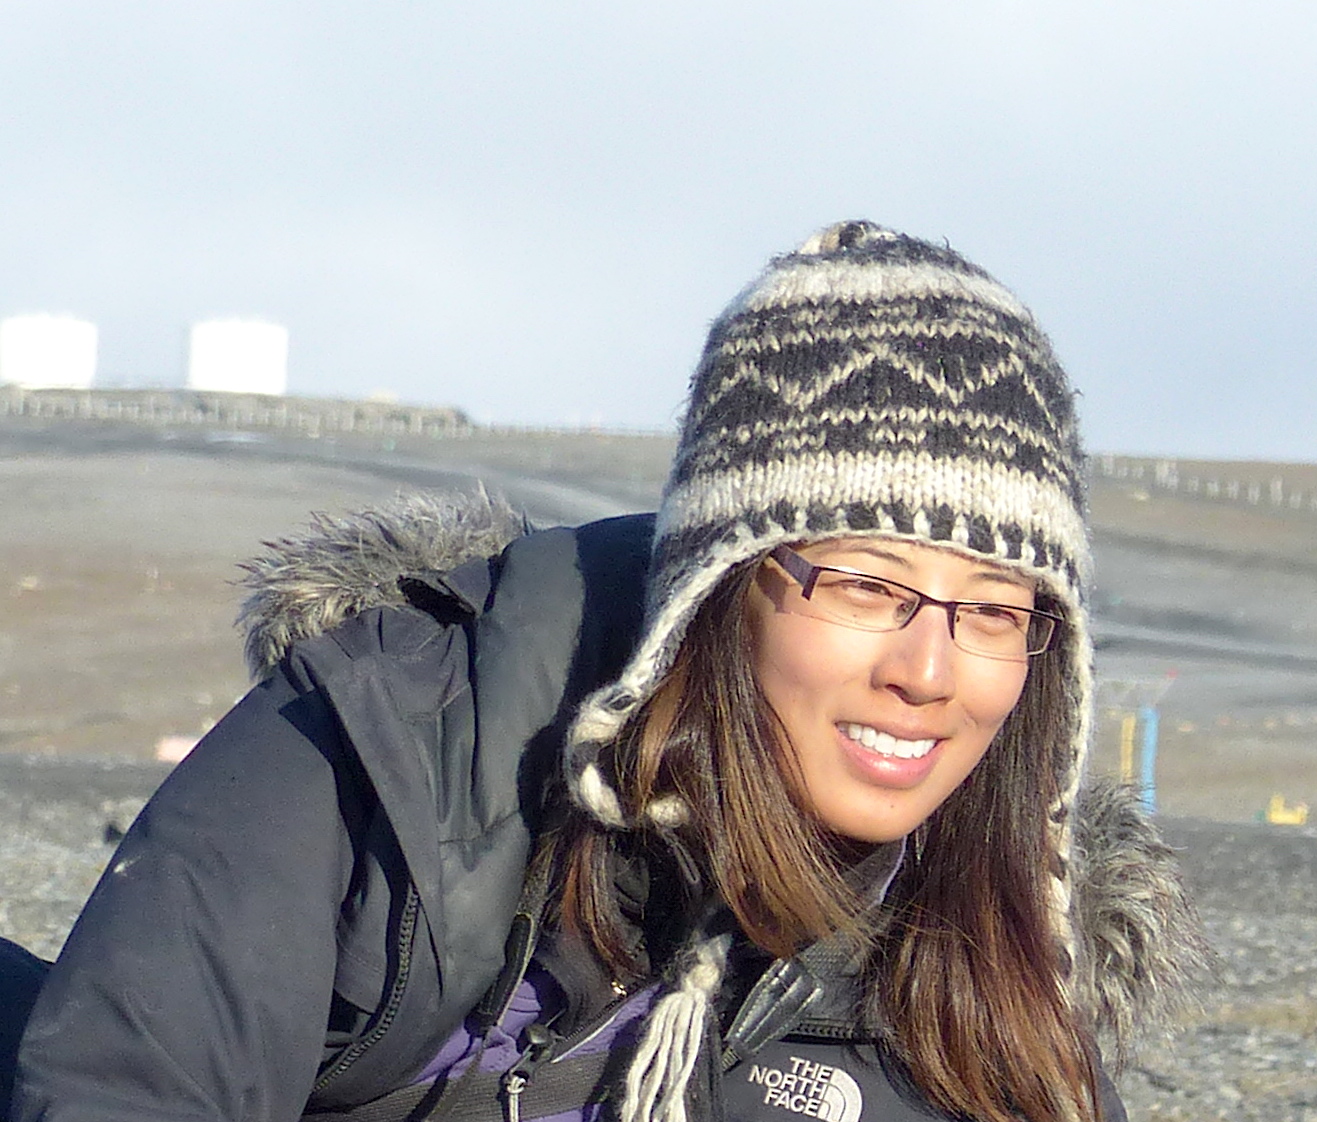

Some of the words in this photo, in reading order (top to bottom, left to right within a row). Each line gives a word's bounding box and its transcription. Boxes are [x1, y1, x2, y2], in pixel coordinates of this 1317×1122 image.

[748, 1065, 828, 1100] NORTH
[789, 1056, 833, 1083] THE
[763, 1087, 822, 1117] FACE
